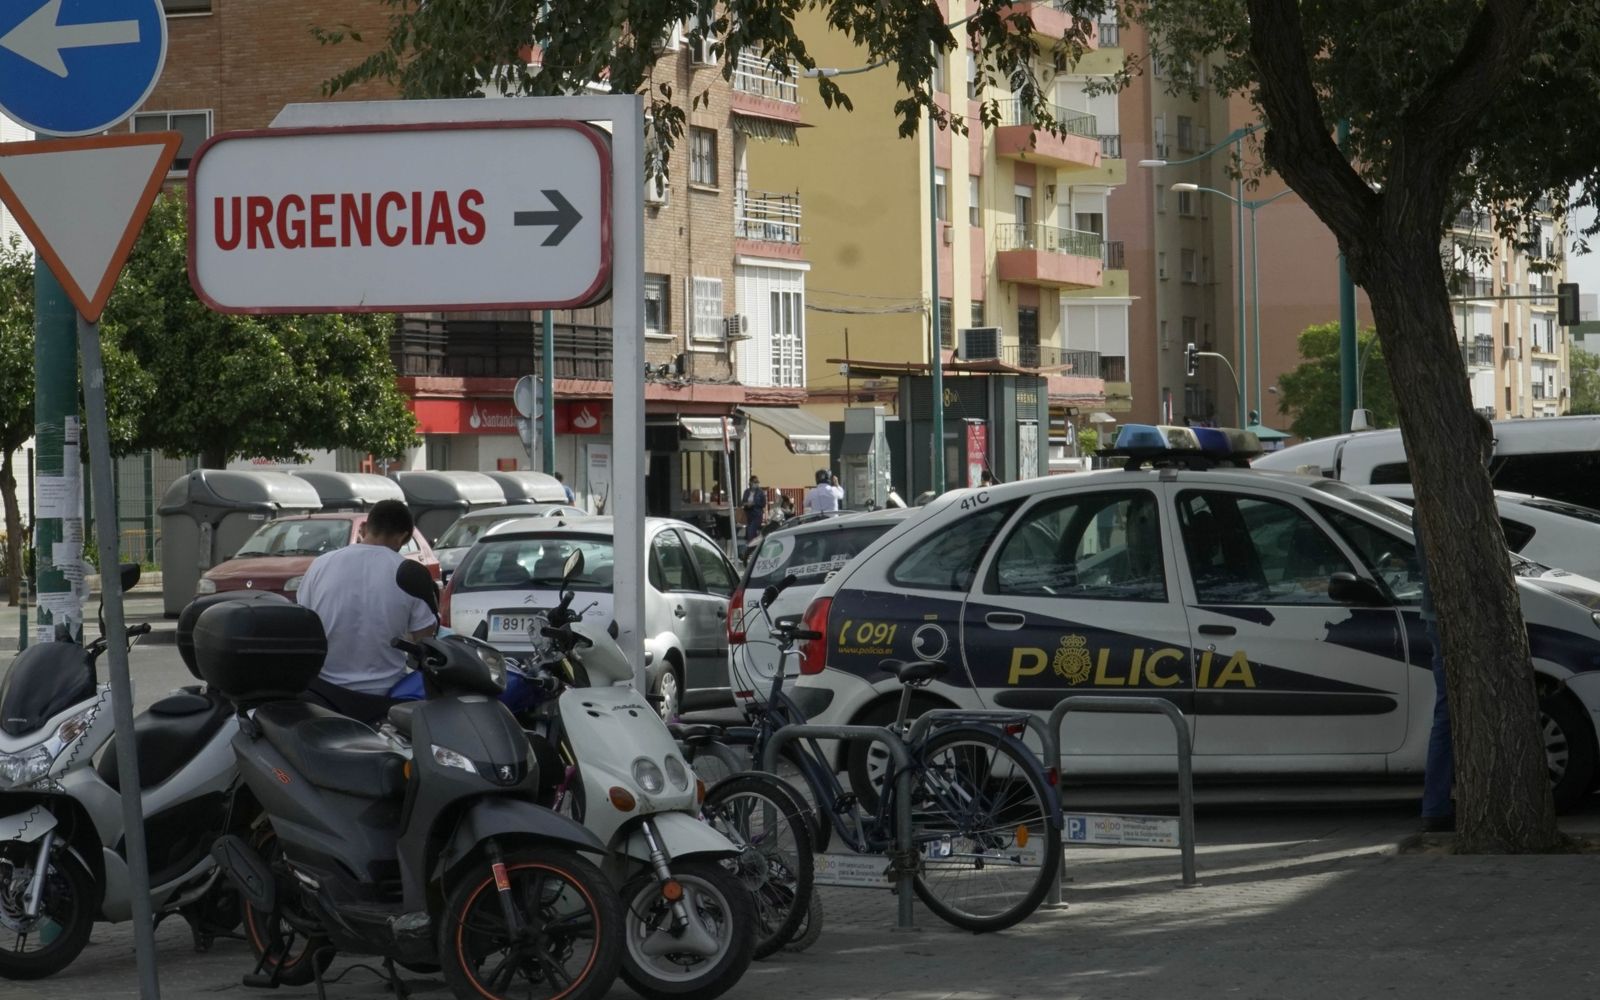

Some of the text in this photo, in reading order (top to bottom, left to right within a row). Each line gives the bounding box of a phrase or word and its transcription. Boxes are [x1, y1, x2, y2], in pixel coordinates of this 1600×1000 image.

[213, 188, 486, 251] URGENCIAS
[482, 408, 519, 428] Santand
[960, 491, 991, 511] 41C
[856, 622, 897, 645] 091
